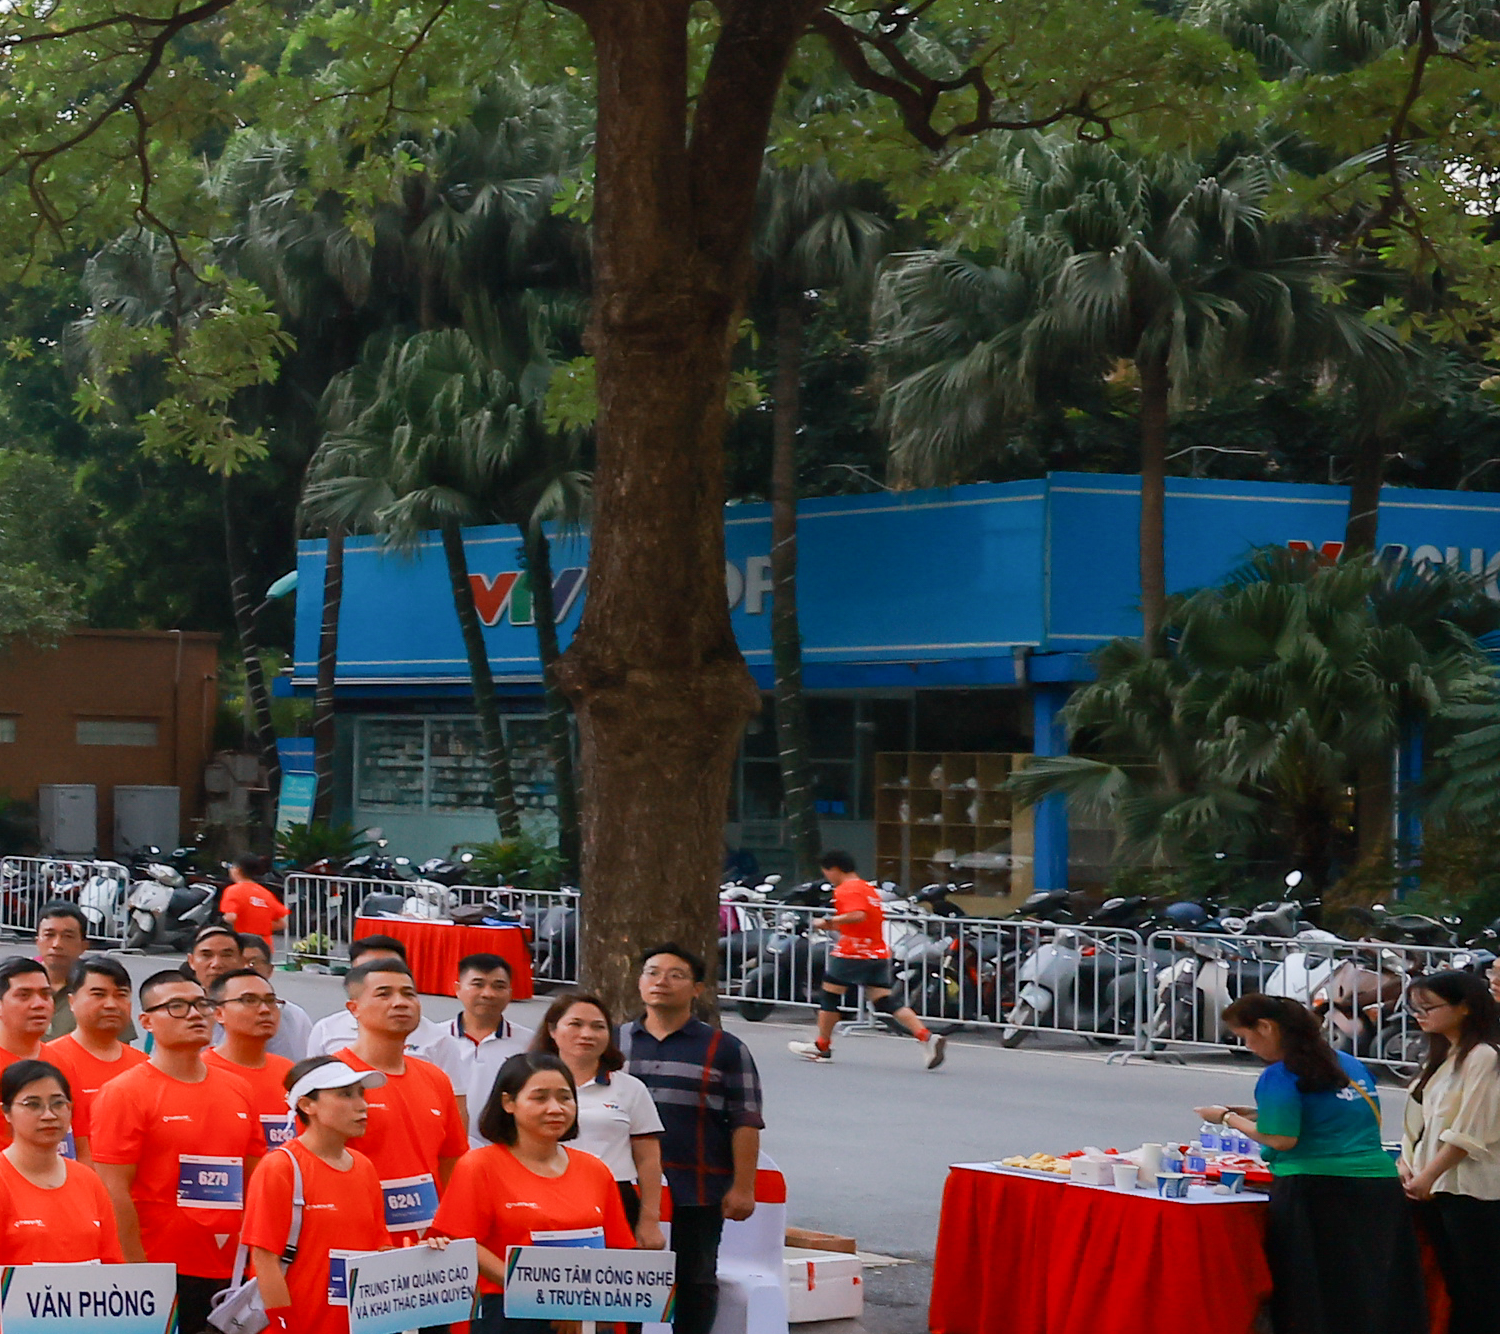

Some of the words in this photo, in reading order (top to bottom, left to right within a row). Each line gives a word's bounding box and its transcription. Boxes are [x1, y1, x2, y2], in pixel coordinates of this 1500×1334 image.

[387, 1192, 422, 1209] 6241
[516, 1266, 561, 1283] TRUNG
[565, 1264, 591, 1284] TÂM
[595, 1266, 633, 1285] CÔNG
[358, 1281, 390, 1299] TRUNG
[536, 1288, 545, 1304] &
[636, 1292, 652, 1308] PS
[27, 1285, 71, 1318] VĂN
[79, 1283, 155, 1317] PHÒNG
[370, 1302, 391, 1317] KHAI
